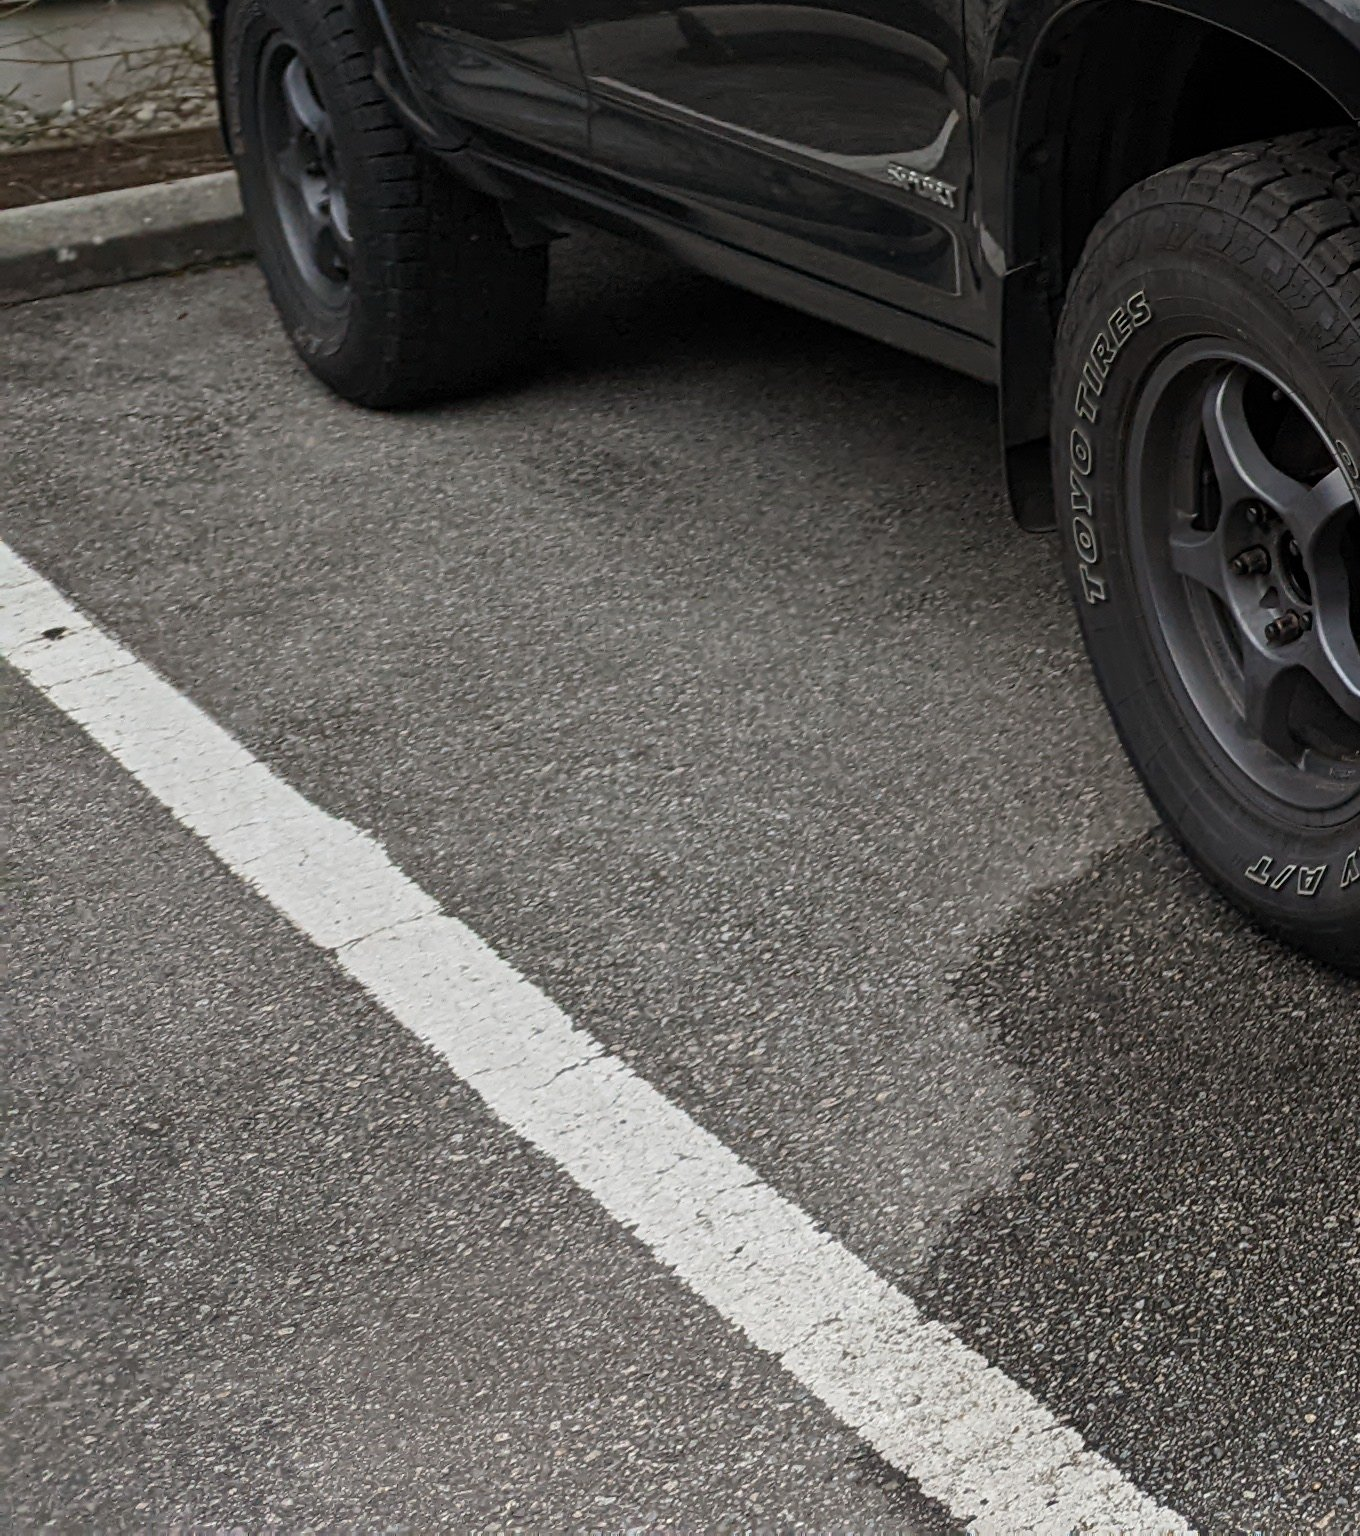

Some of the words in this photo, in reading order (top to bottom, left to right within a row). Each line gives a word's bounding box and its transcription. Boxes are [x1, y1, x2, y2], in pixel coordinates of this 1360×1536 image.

[1075, 290, 1151, 423] TIRES
[1070, 427, 1106, 604] TOYO
[1244, 855, 1327, 895] A/T
